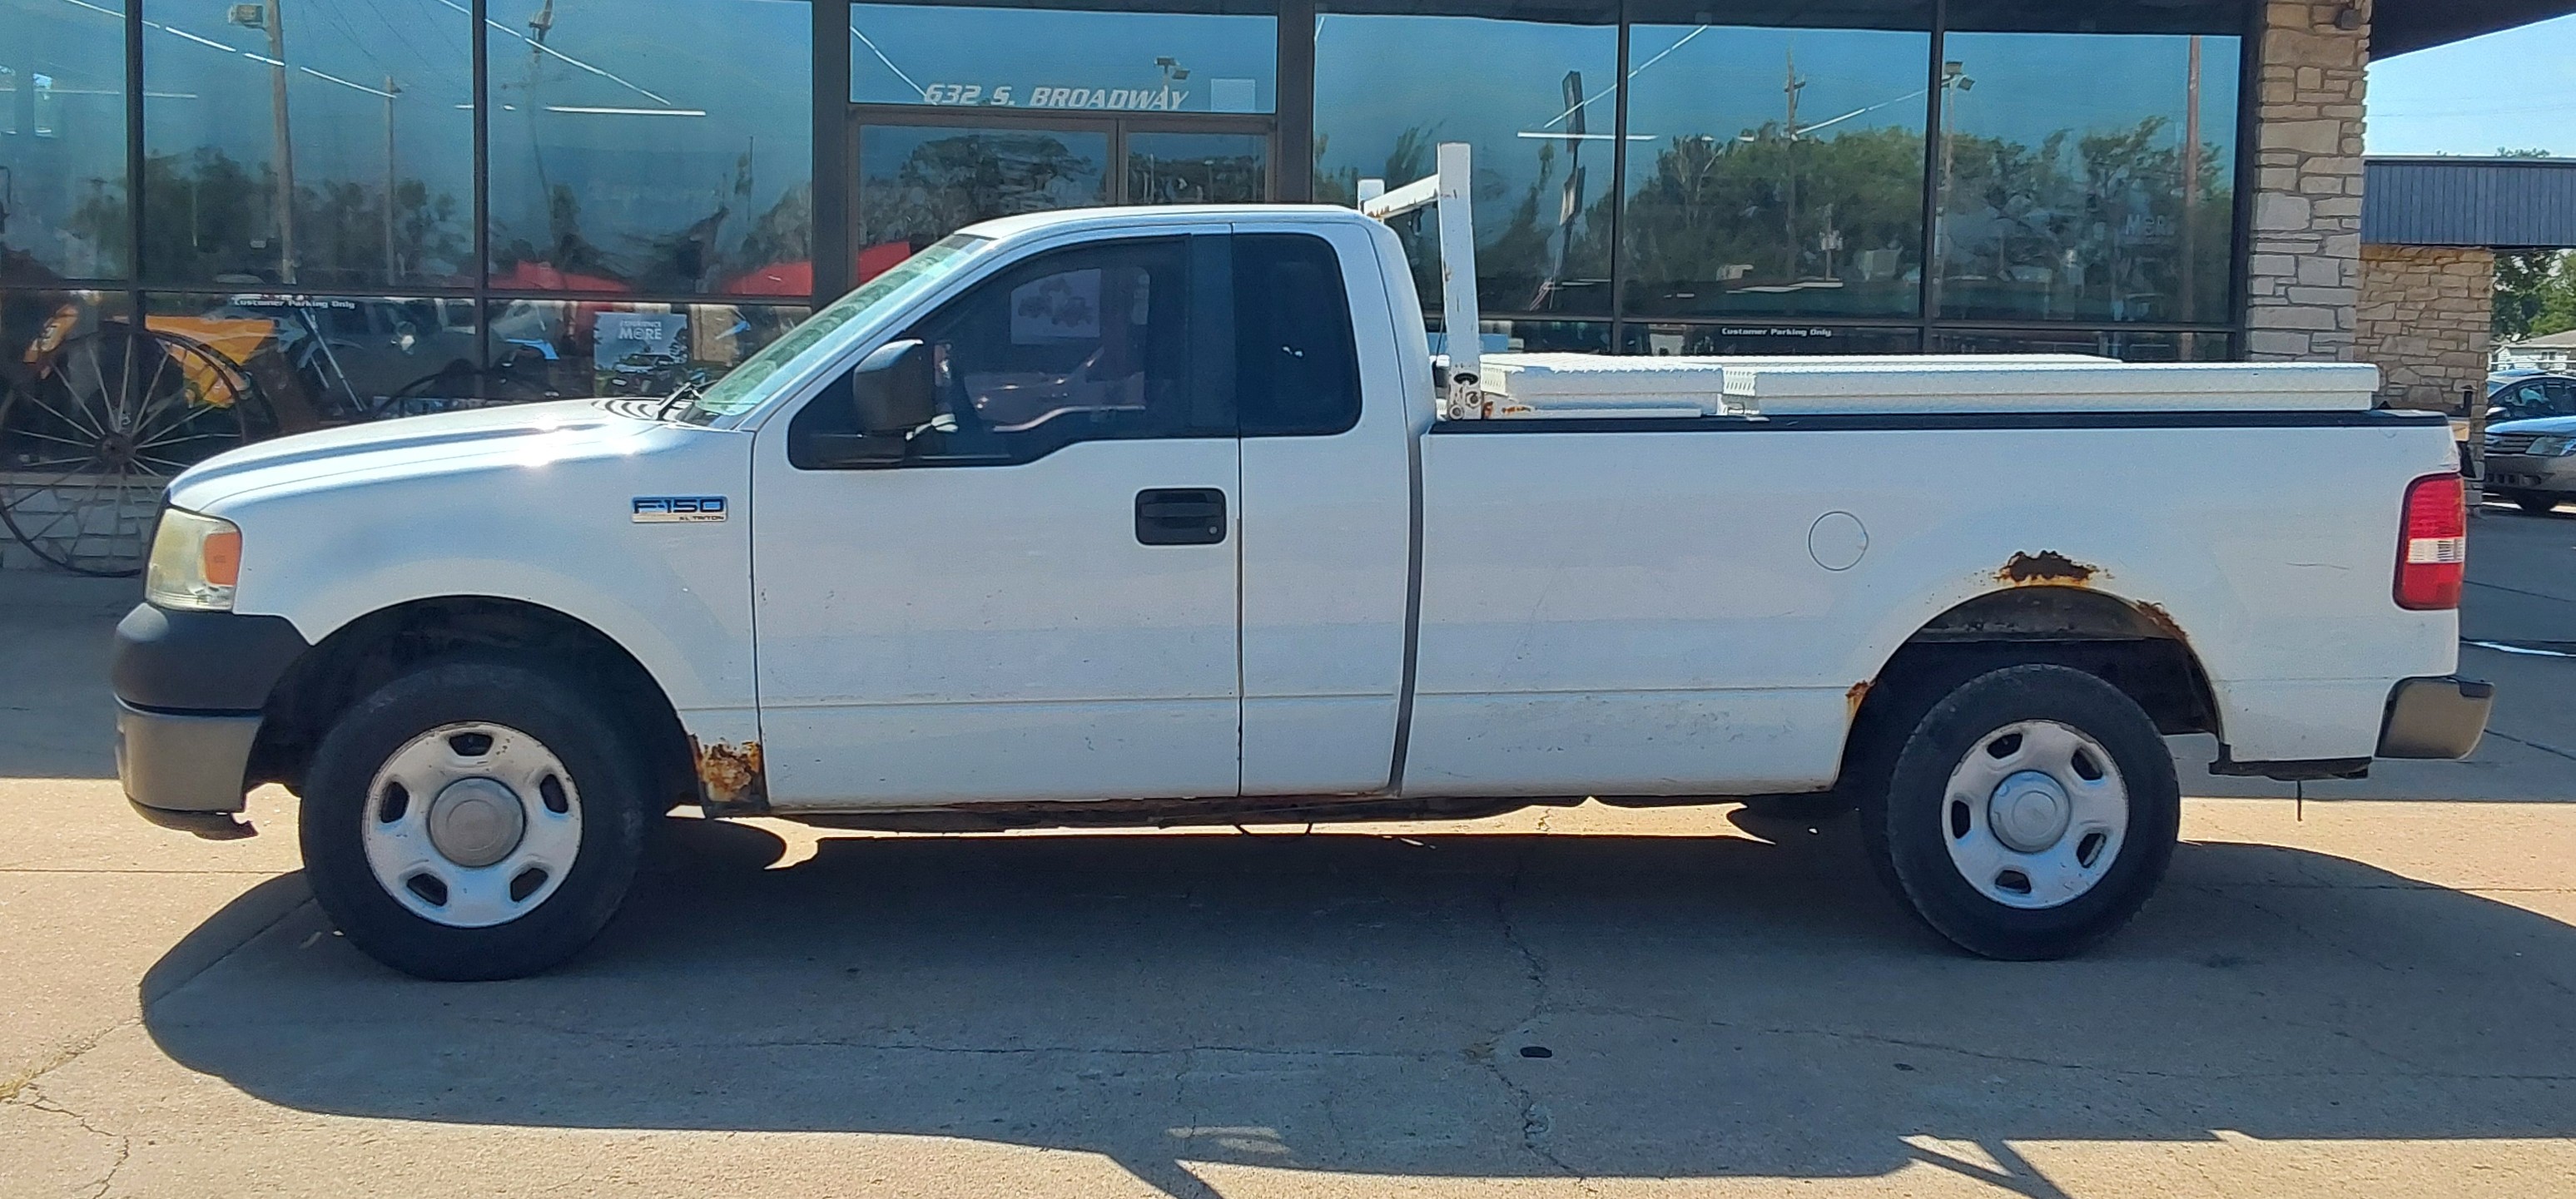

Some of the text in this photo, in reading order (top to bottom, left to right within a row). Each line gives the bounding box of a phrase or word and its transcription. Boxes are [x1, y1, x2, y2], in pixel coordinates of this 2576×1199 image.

[924, 83, 1189, 111] 632 S. BROADWAY
[288, 300, 329, 309] Parking
[331, 300, 355, 310] Only
[618, 327, 663, 340] MORE
[1721, 327, 1832, 337] Customer Parking Only
